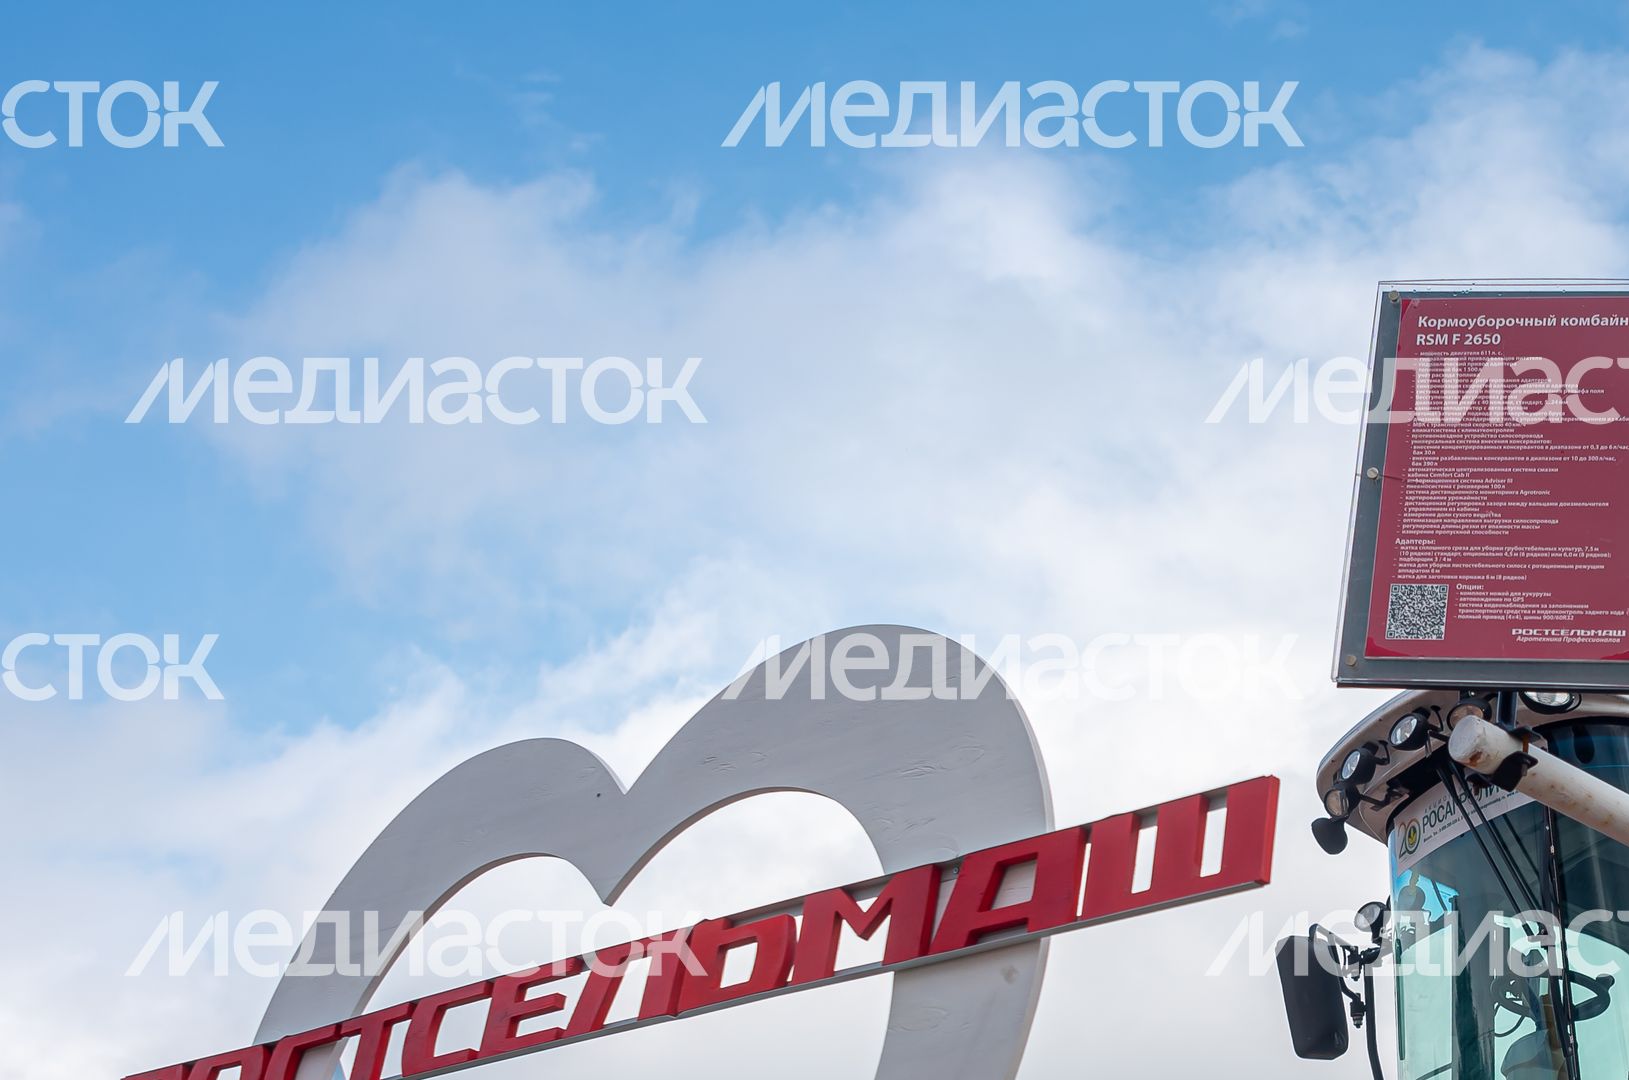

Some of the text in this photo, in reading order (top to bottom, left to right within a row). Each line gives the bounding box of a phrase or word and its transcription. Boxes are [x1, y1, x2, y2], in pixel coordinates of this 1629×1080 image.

[1418, 315, 1629, 330] Кормоуборочный комбайн
[1416, 333, 1501, 346] RSM F 2650
[1395, 538, 1436, 546] Адаптеры:
[1512, 628, 1626, 636] РОСТСЕЛЬМАШ
